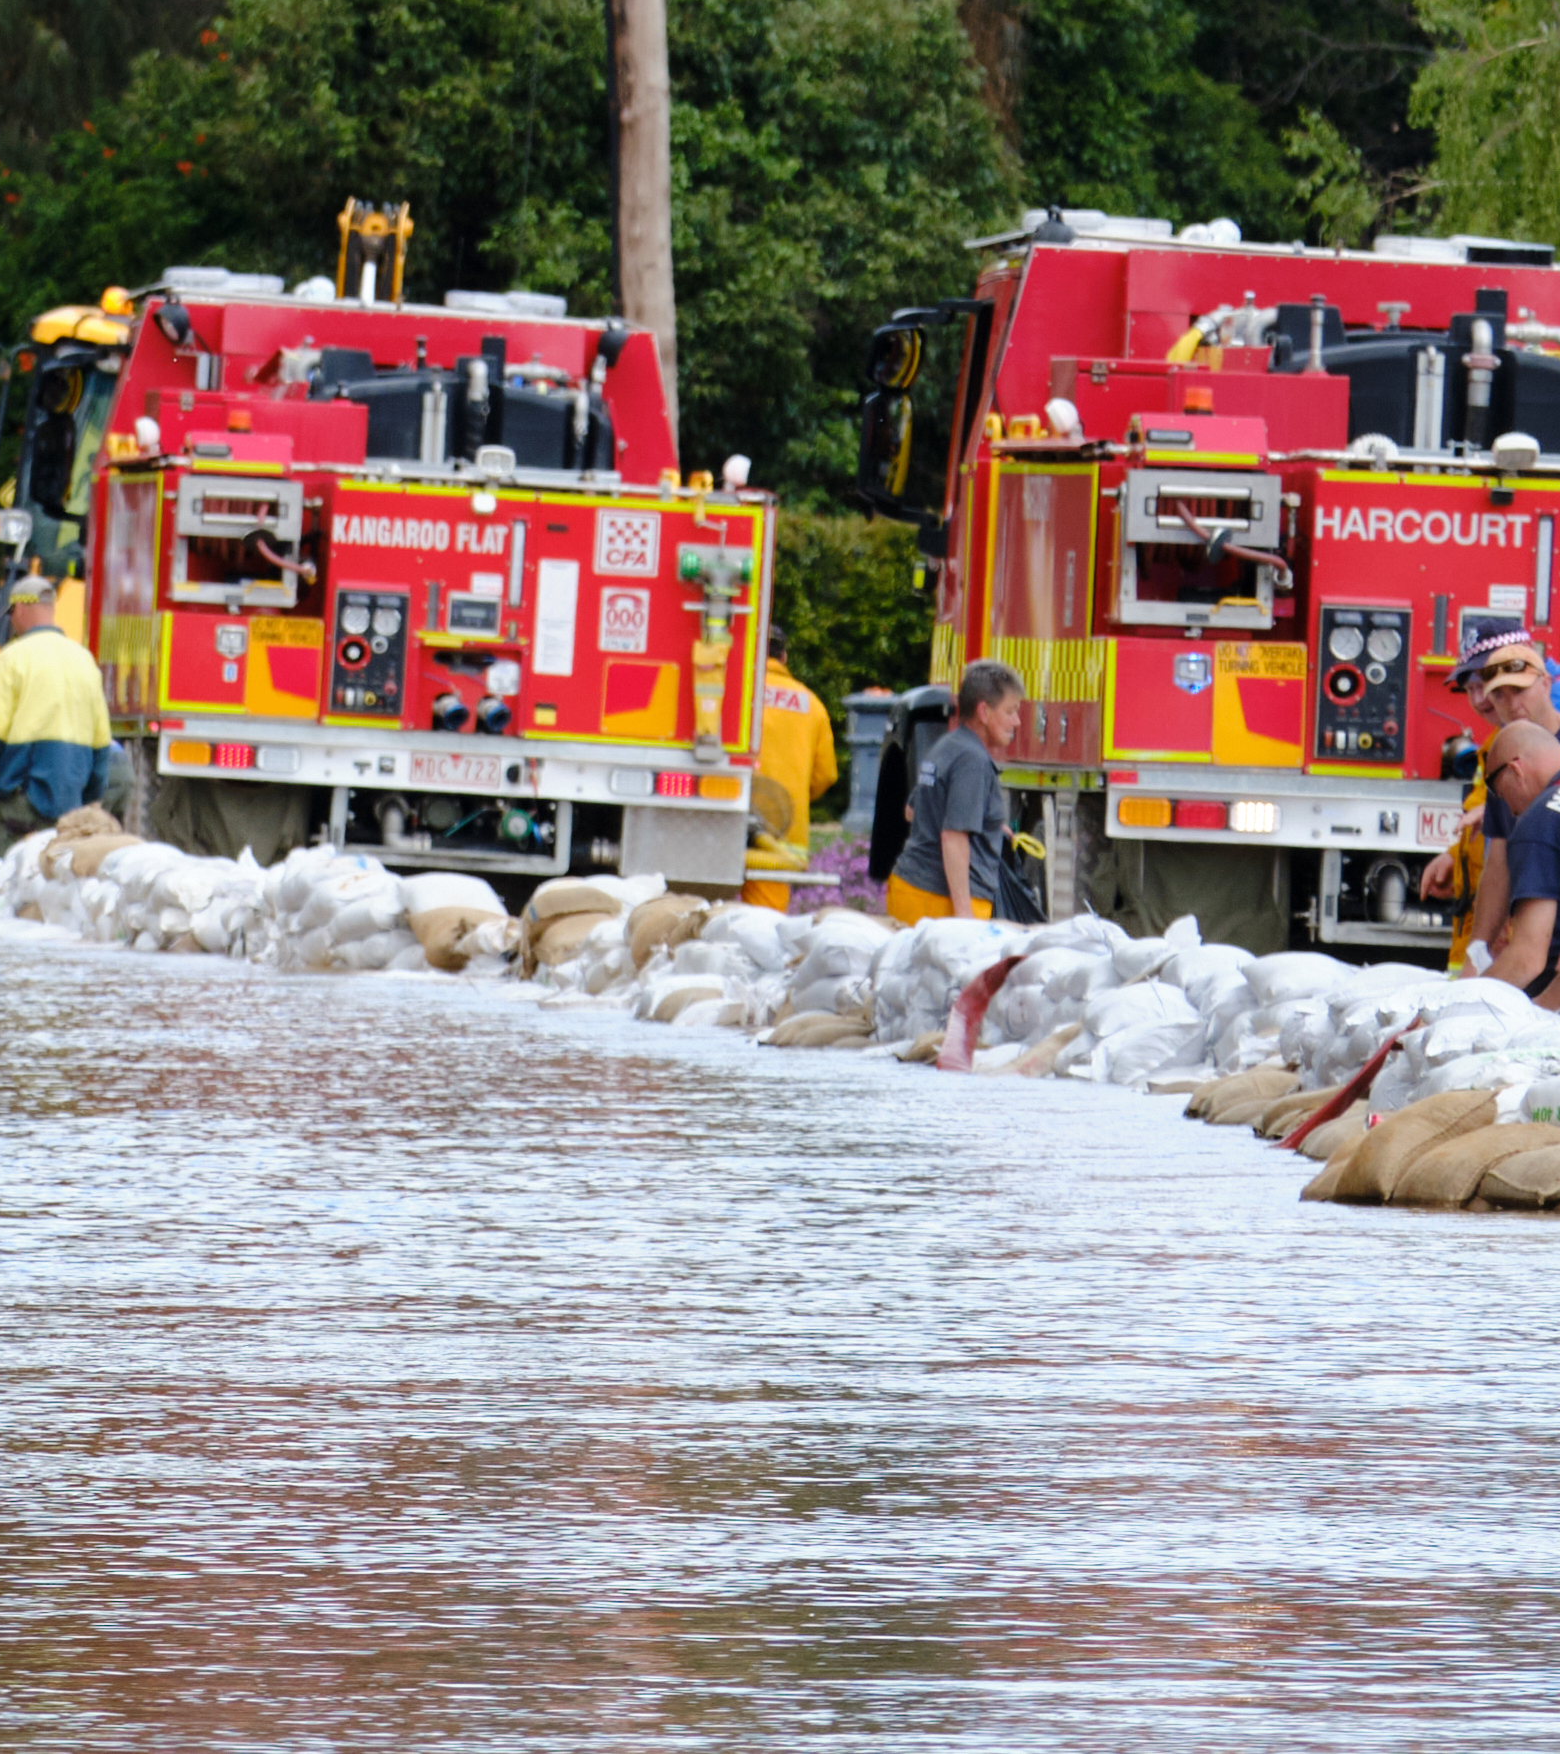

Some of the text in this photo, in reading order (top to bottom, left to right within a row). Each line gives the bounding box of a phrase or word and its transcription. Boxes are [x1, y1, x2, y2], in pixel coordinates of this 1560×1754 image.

[332, 513, 509, 555] KANGAROO FLAT
[1314, 505, 1532, 548] HARCOURT
[605, 548, 648, 567] CFA
[605, 608, 645, 628] 000
[414, 757, 447, 779] MDC
